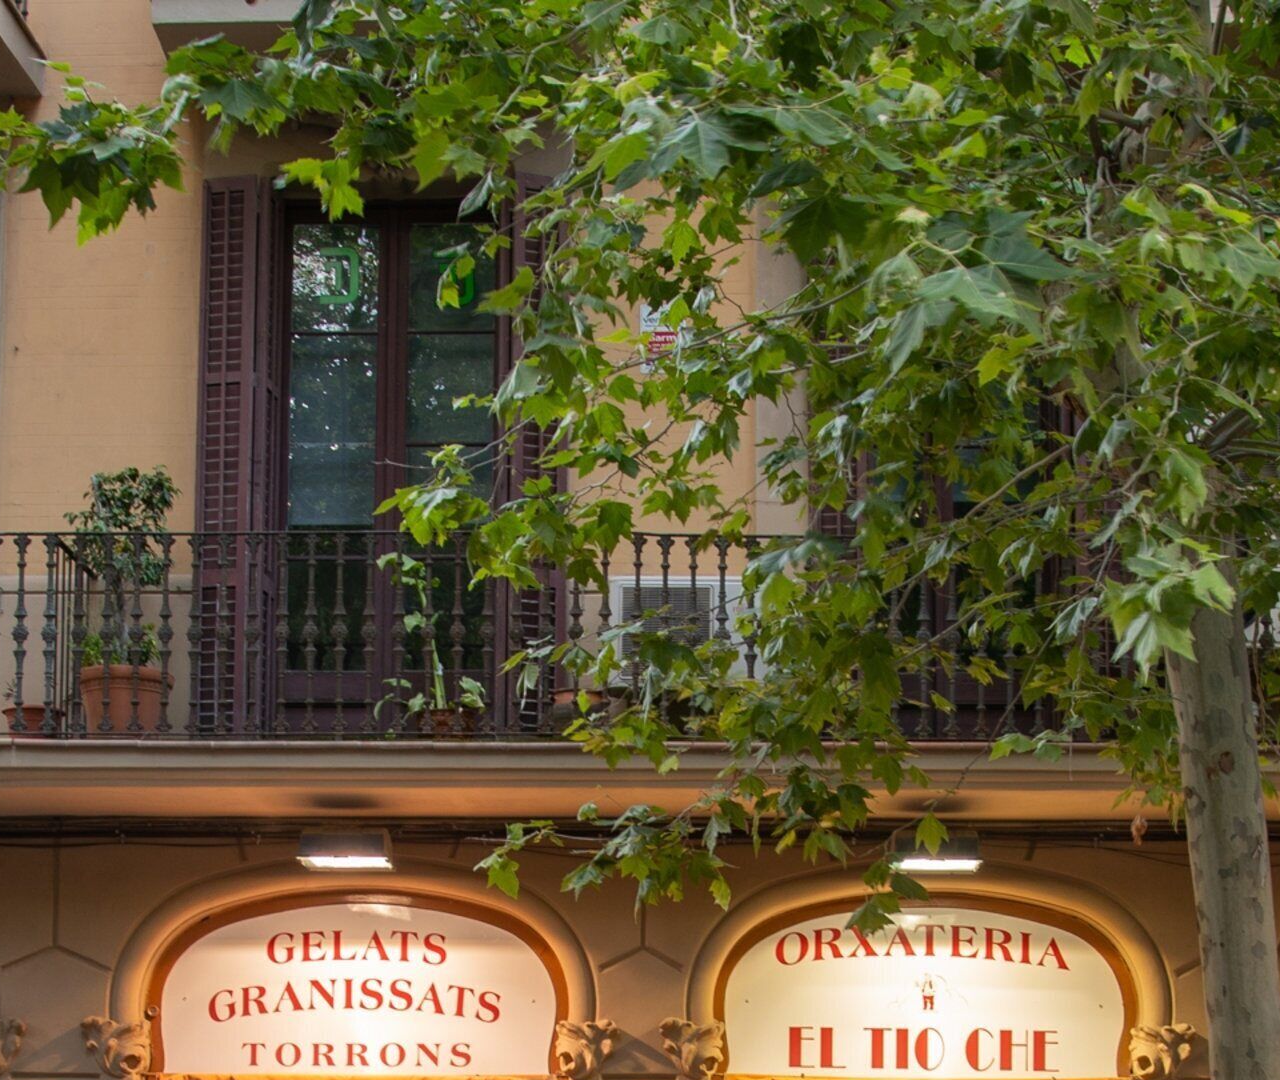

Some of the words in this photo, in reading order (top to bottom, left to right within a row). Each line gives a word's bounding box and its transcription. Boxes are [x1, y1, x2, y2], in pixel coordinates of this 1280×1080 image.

[266, 929, 449, 966] GELATS
[774, 923, 1071, 971] ORXATERIA
[208, 979, 503, 1023] GRANISSATS
[241, 1041, 472, 1068] TORRONS
[787, 1025, 847, 1069] EL
[863, 1026, 946, 1071] TIO
[964, 1027, 1060, 1072] CHE
